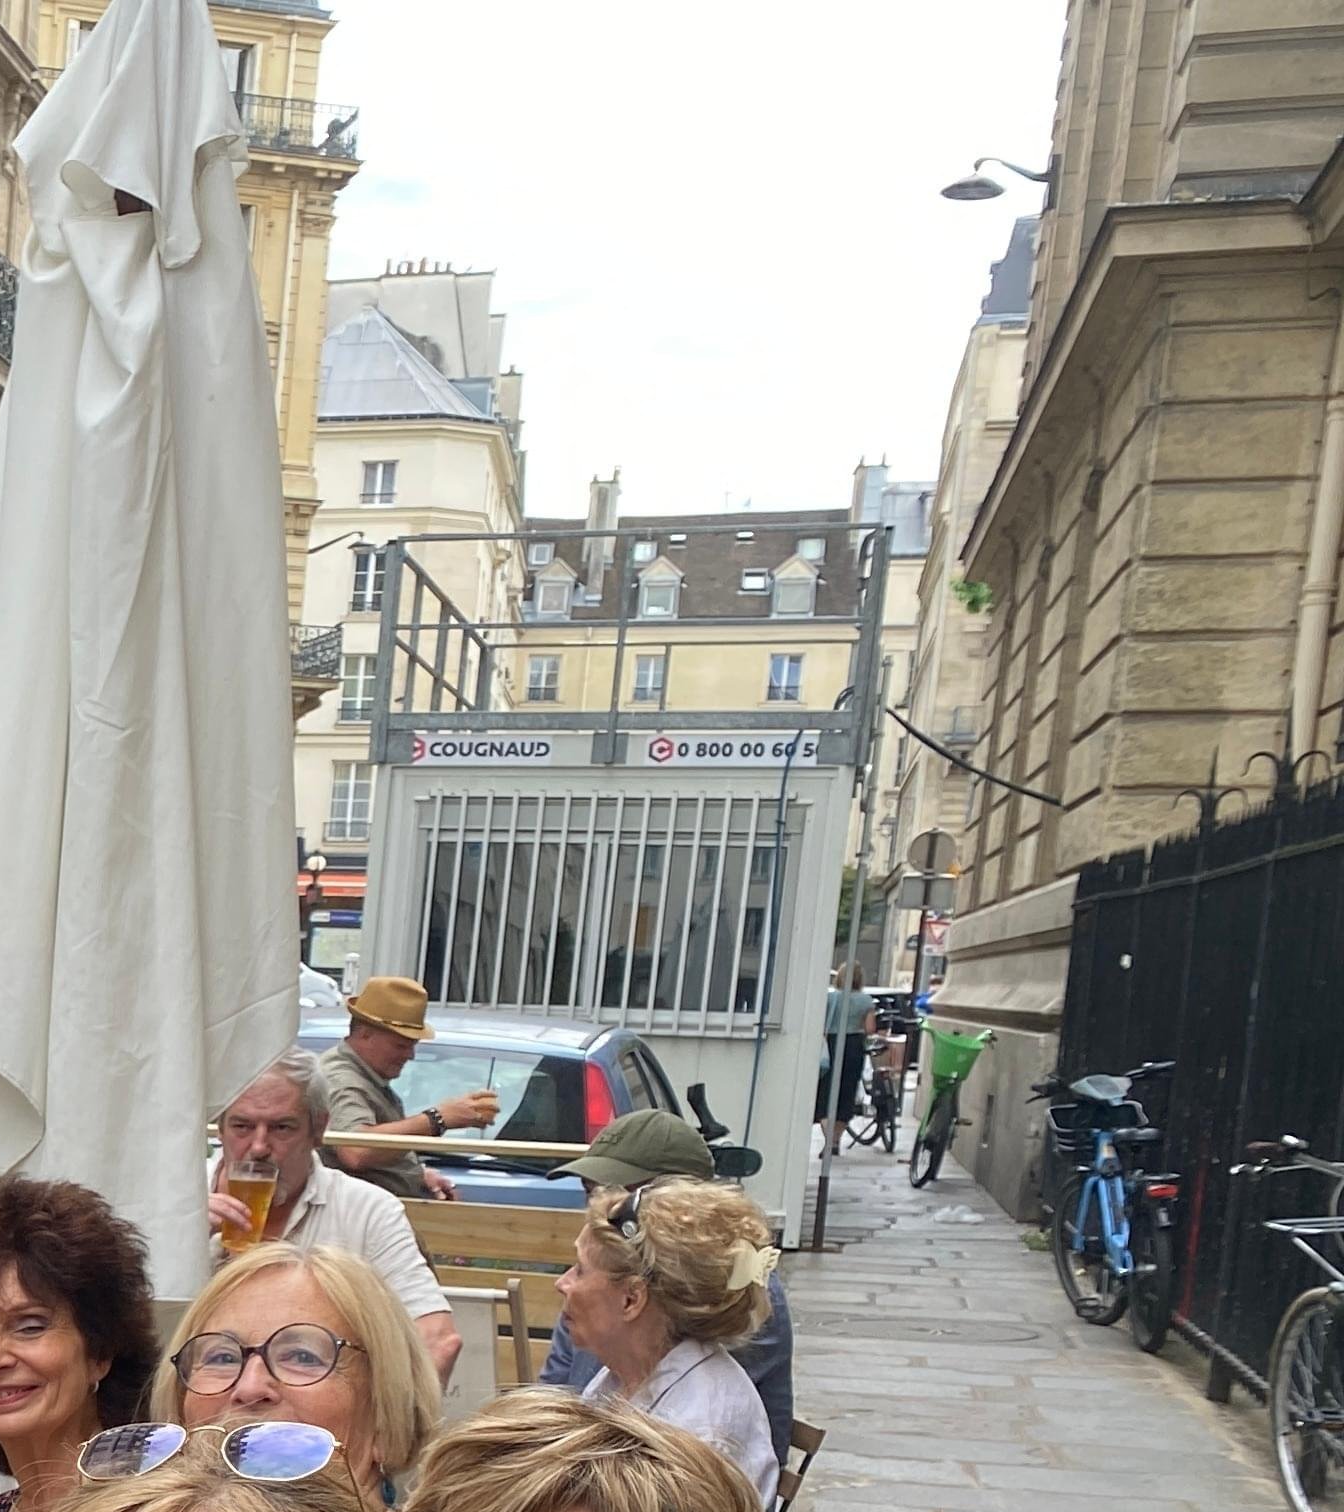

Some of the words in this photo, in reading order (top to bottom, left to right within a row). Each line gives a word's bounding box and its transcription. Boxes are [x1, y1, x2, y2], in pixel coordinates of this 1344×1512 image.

[429, 741, 551, 758] COUGNAUD
[678, 742, 690, 758] 0
[695, 742, 734, 758] 800
[740, 742, 765, 758] 00
[771, 742, 797, 758] 60
[802, 743, 819, 758] 5
